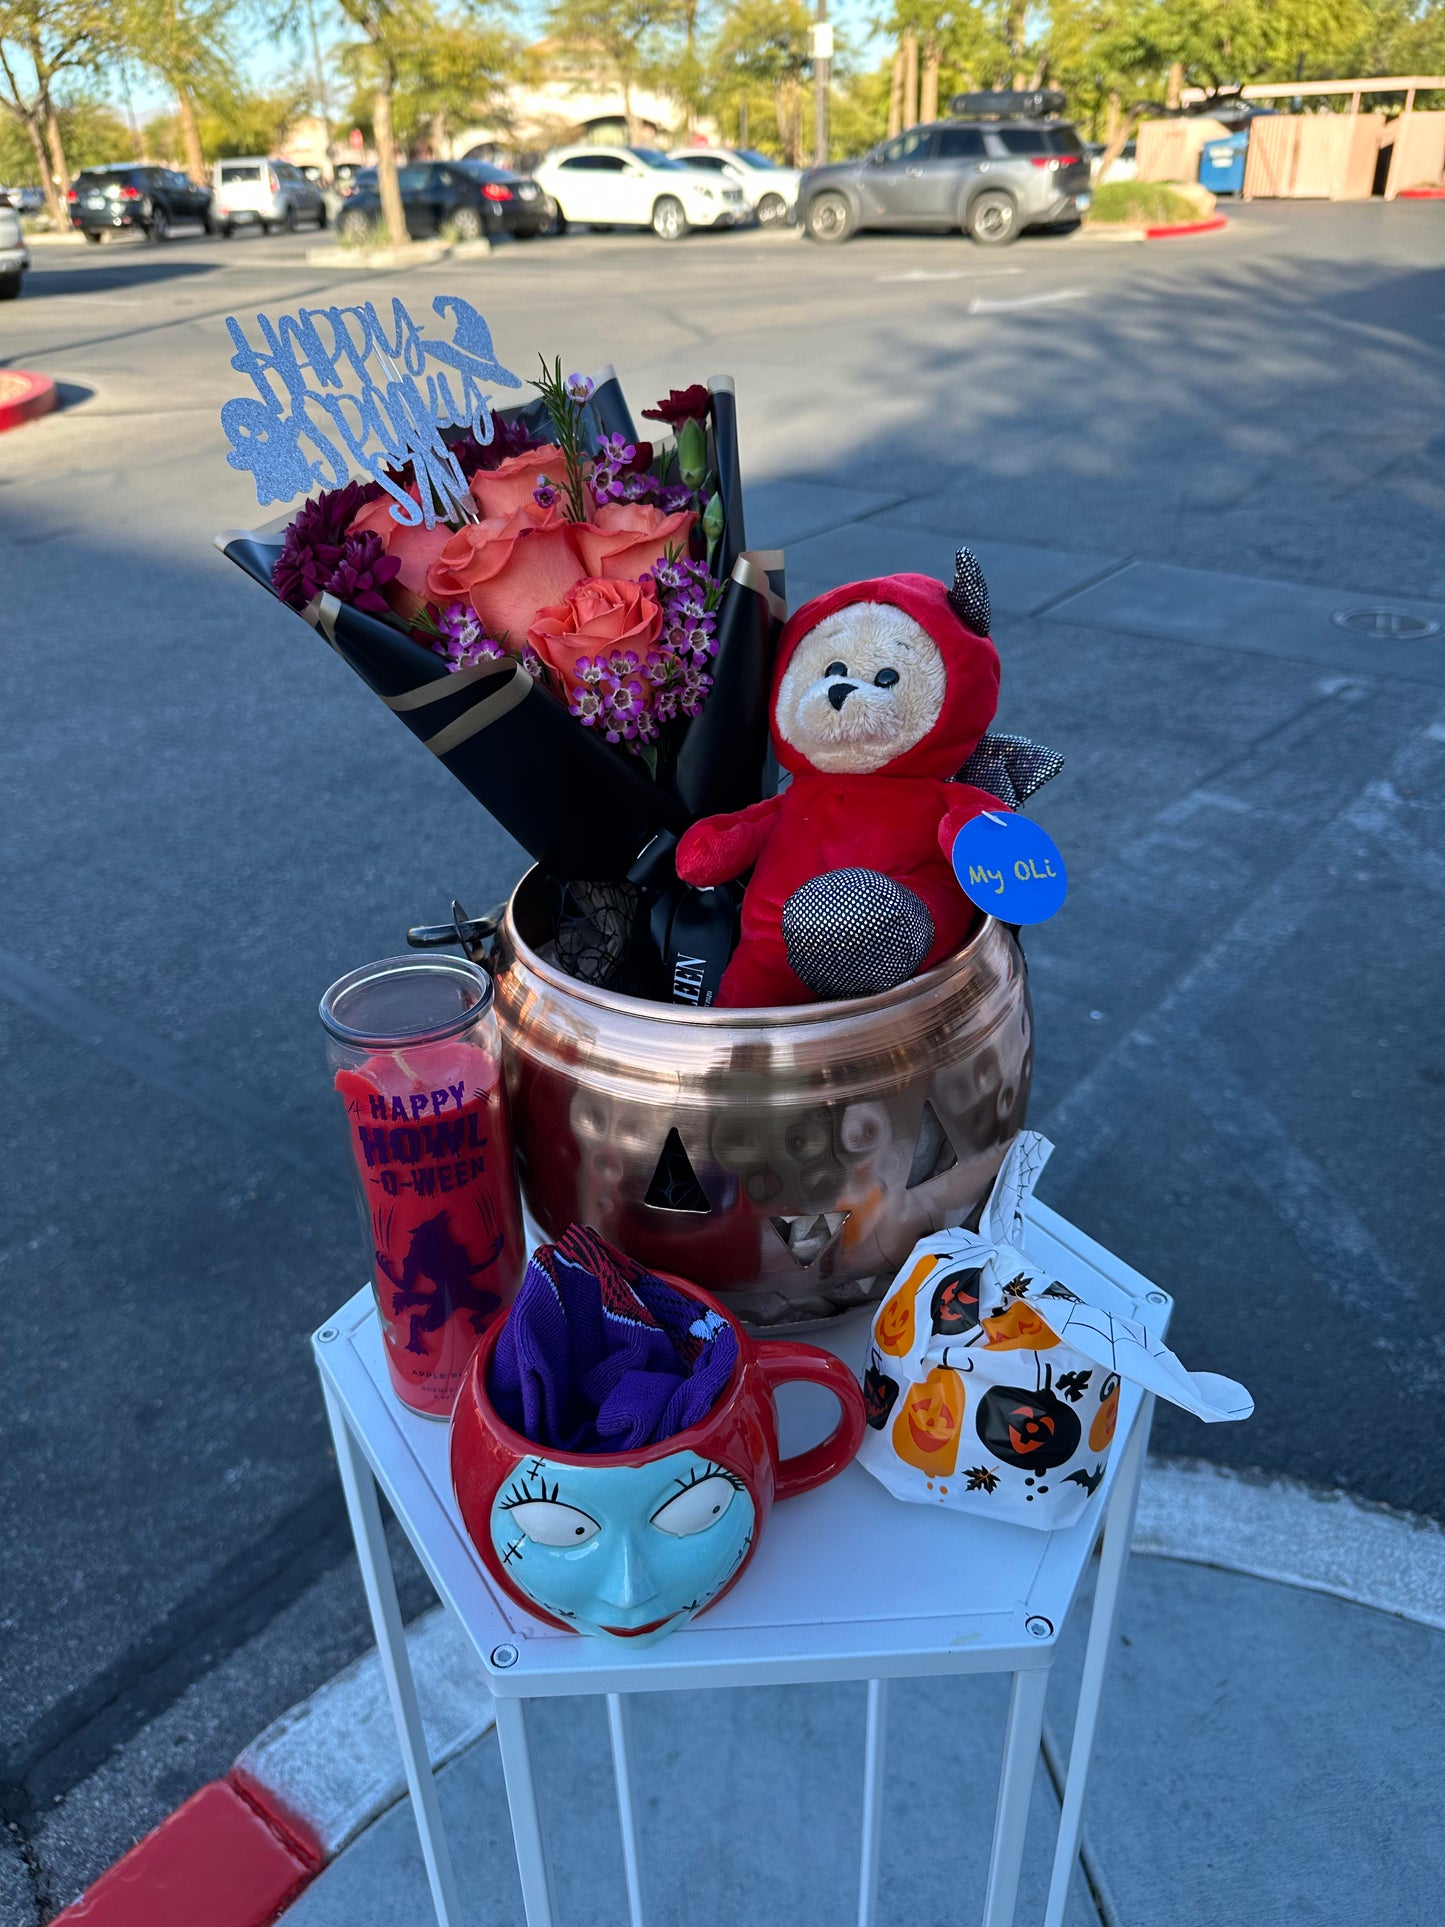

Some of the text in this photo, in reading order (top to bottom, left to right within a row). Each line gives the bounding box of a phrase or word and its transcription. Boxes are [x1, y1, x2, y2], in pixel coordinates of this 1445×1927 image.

[969, 865, 1005, 894] My
[673, 952, 707, 1006] EEN
[368, 1080, 465, 1123] HAPPY
[358, 1112, 488, 1169] HOWL
[411, 1369, 446, 1379] APPLE
